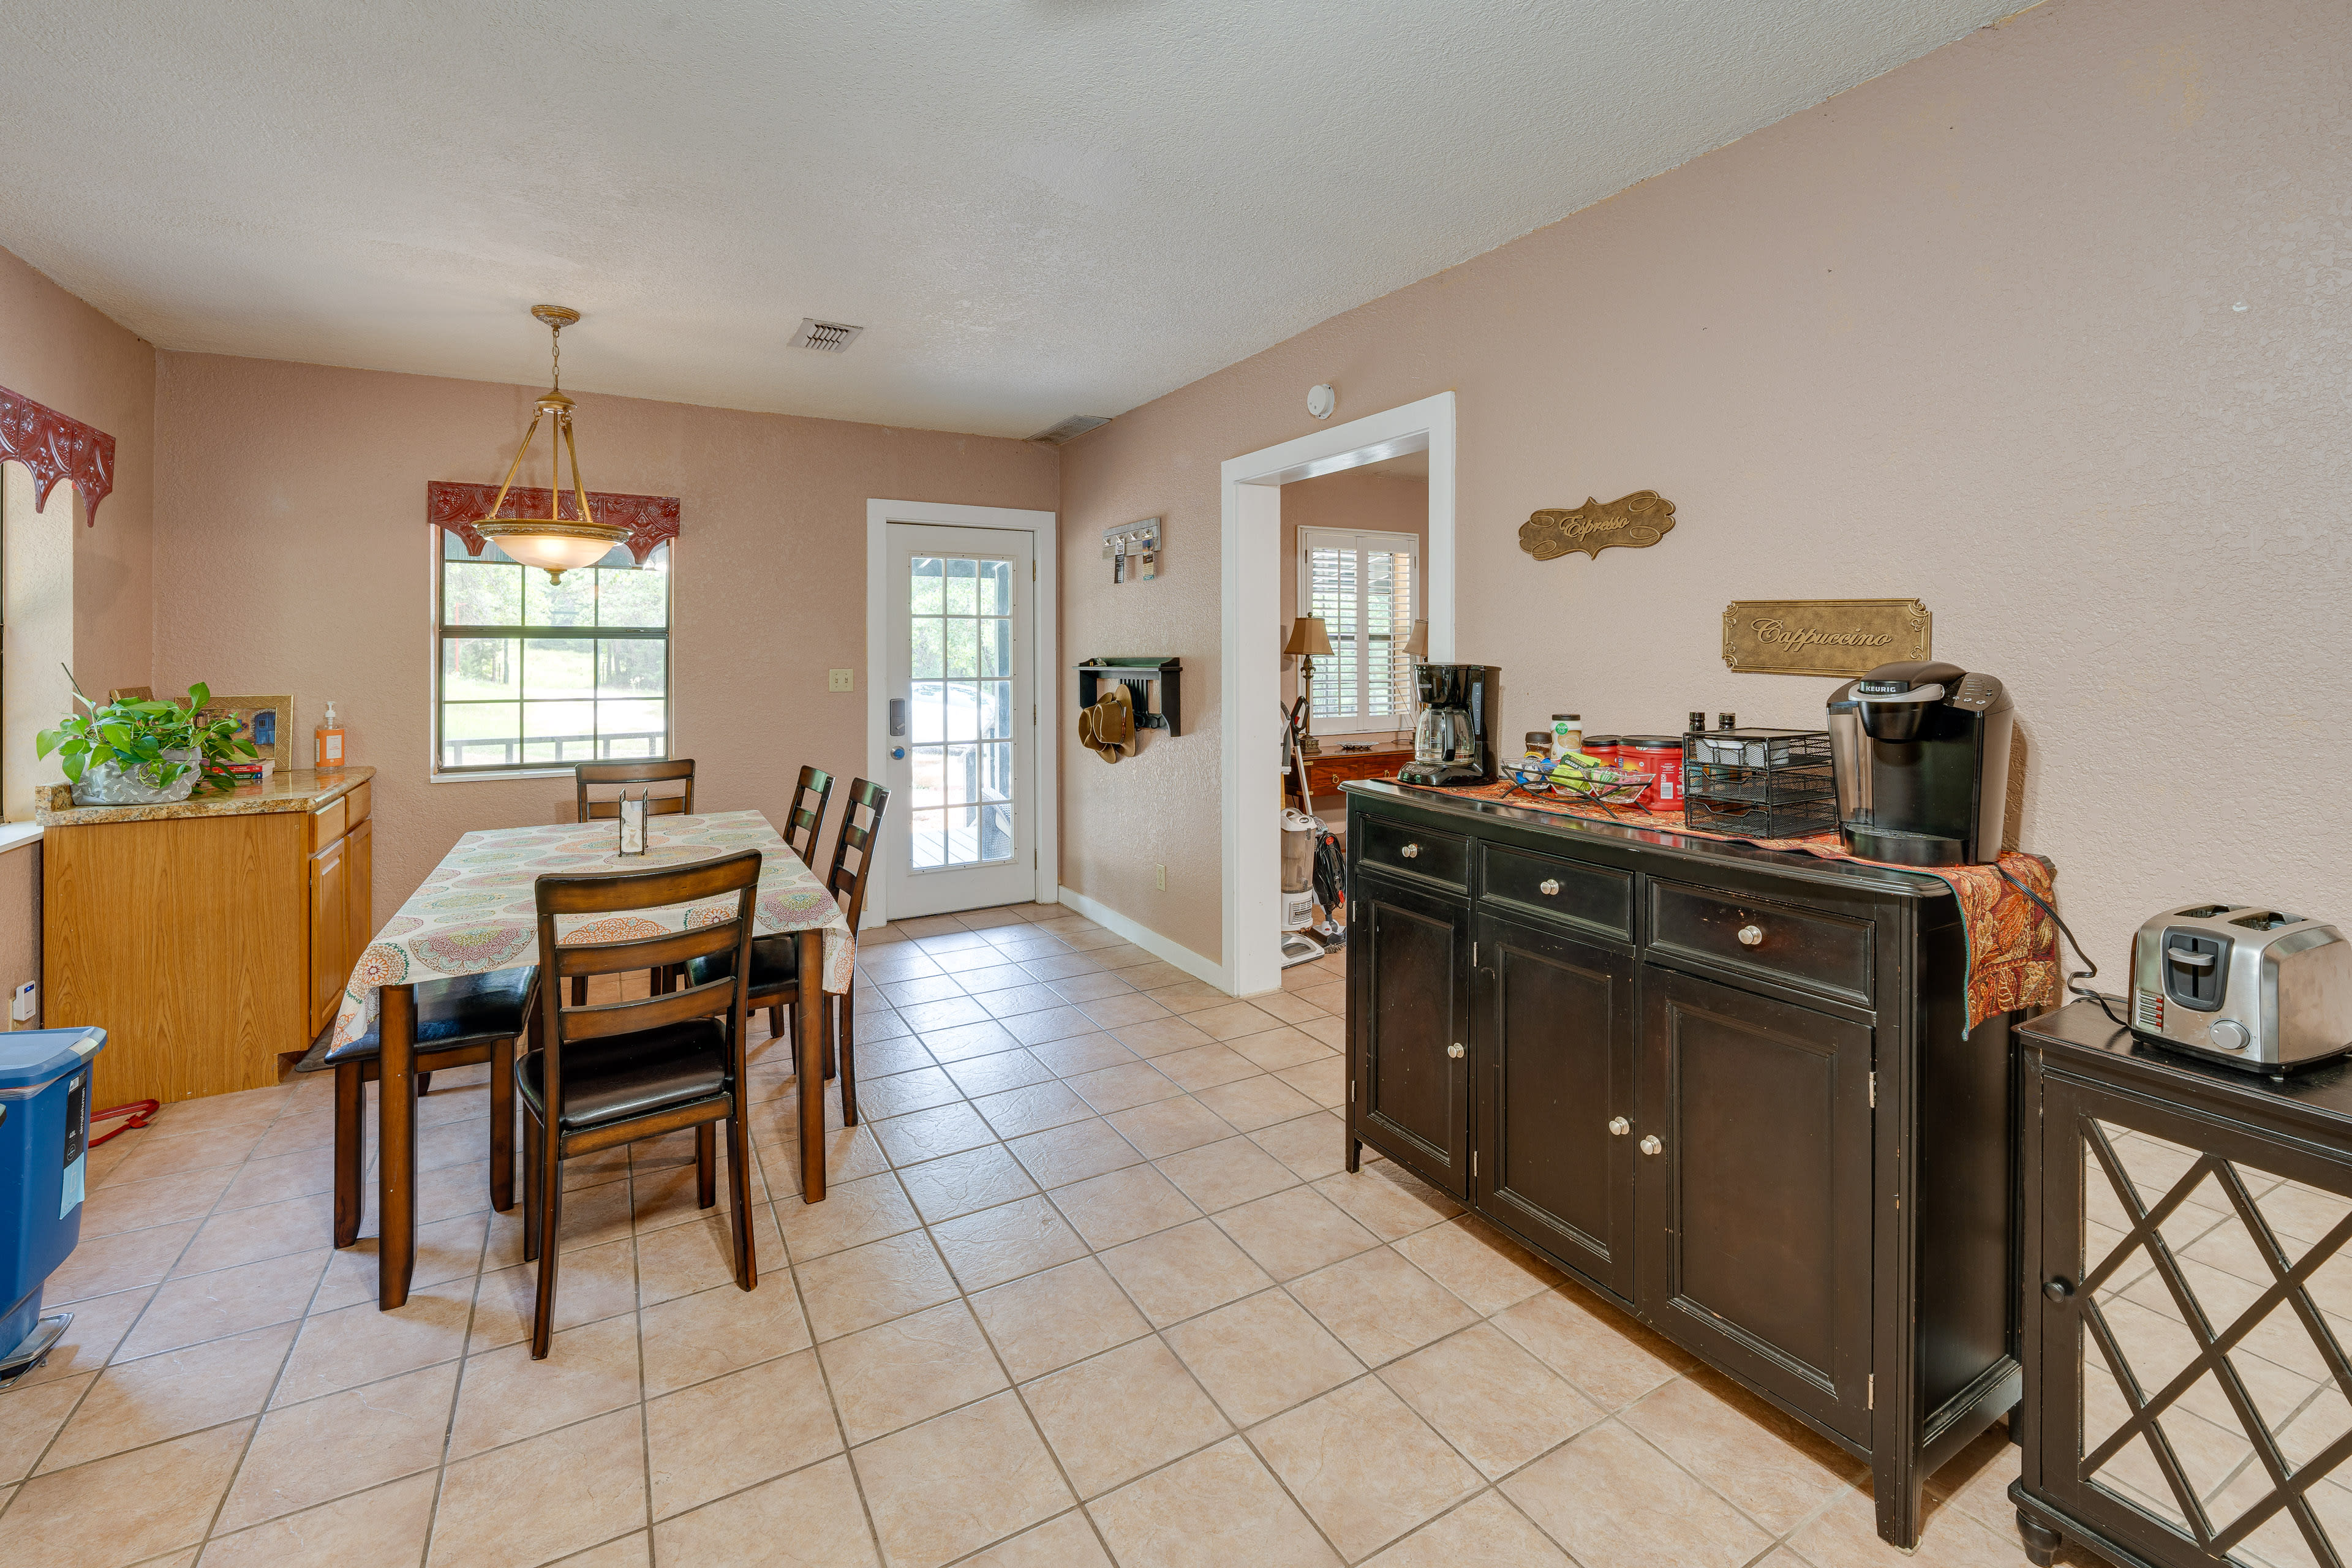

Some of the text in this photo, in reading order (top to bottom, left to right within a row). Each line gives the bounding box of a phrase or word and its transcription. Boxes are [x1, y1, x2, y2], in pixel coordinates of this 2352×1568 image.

[1559, 514, 1630, 542] Espresso
[1750, 617, 1893, 652] Cappuccino
[1564, 760, 1578, 769] GREEN
